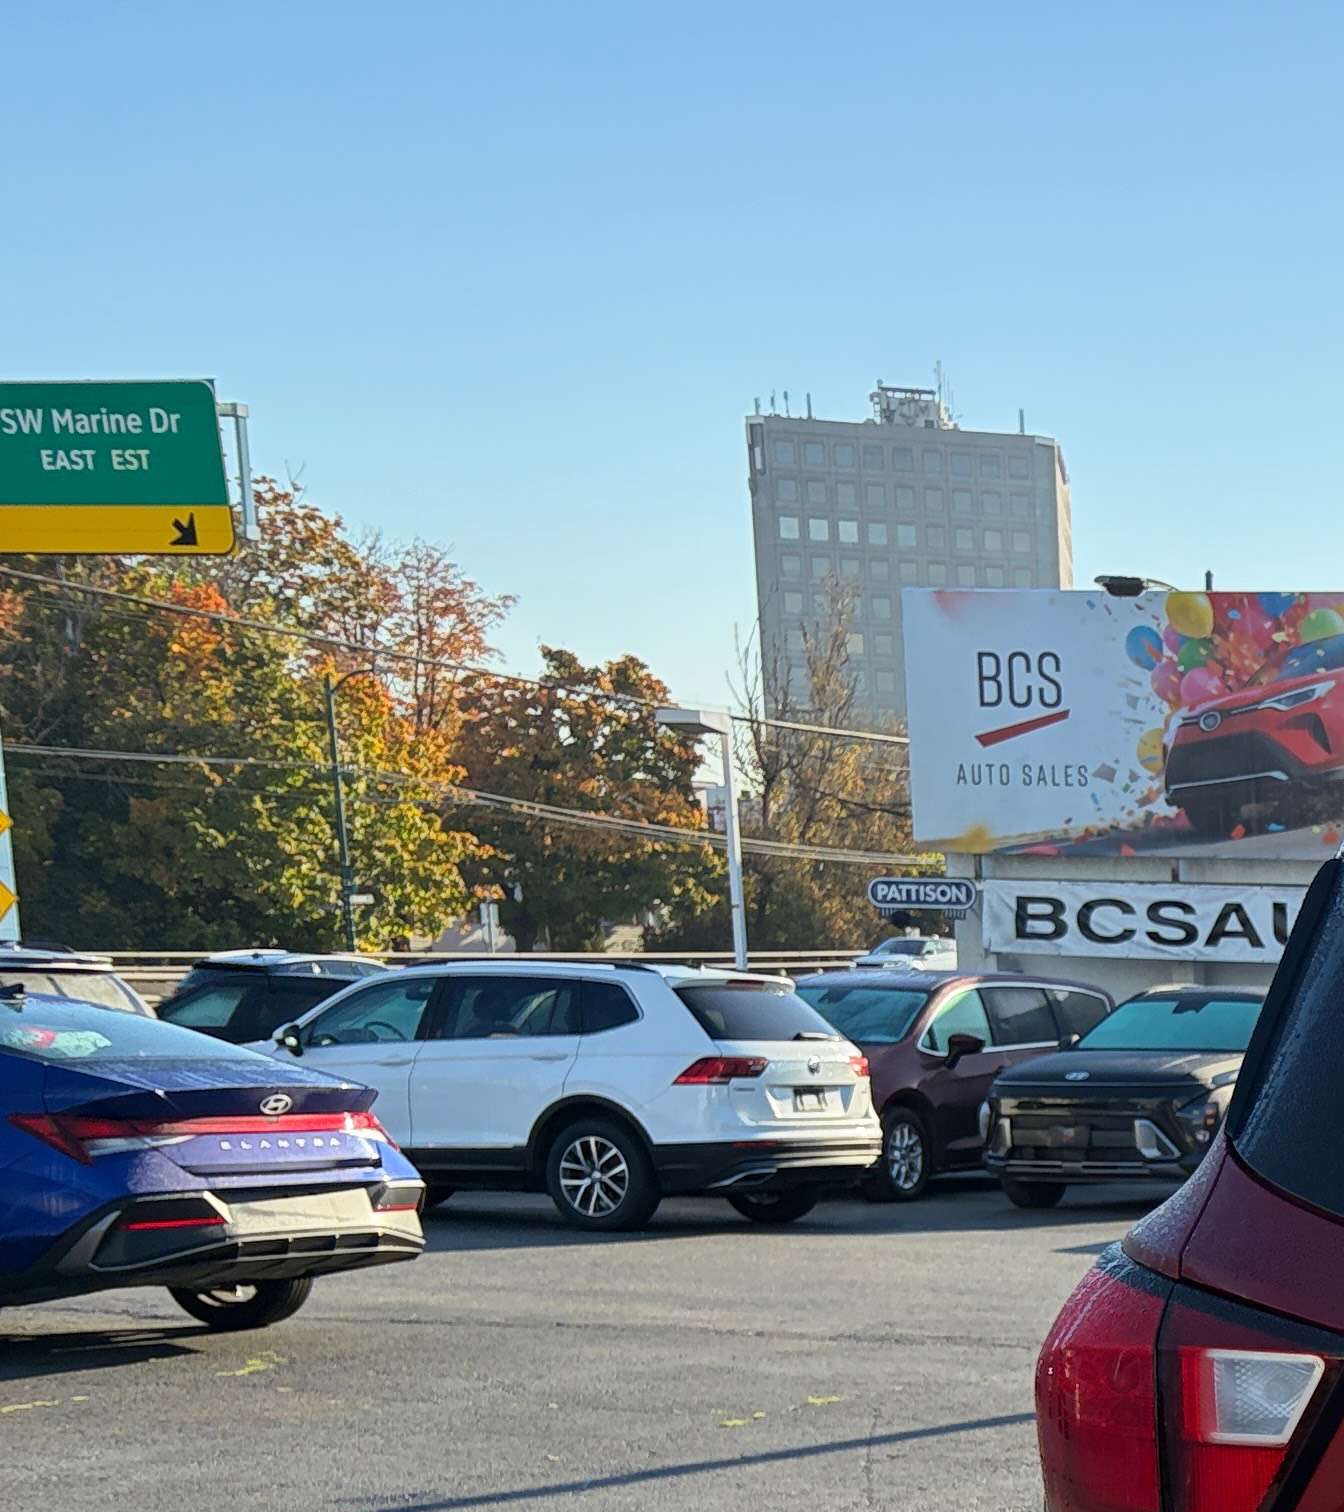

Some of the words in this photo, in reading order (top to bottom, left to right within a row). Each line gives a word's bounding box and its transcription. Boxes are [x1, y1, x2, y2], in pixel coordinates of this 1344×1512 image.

[0, 407, 43, 434] SW
[51, 407, 143, 434] Marine
[149, 406, 181, 433] Dr
[40, 449, 96, 471] EAST
[111, 449, 150, 470] EST
[977, 651, 1063, 708] BCS
[956, 763, 1010, 786] AUTO
[1022, 764, 1089, 787] SALES
[876, 883, 967, 903] PATTISON
